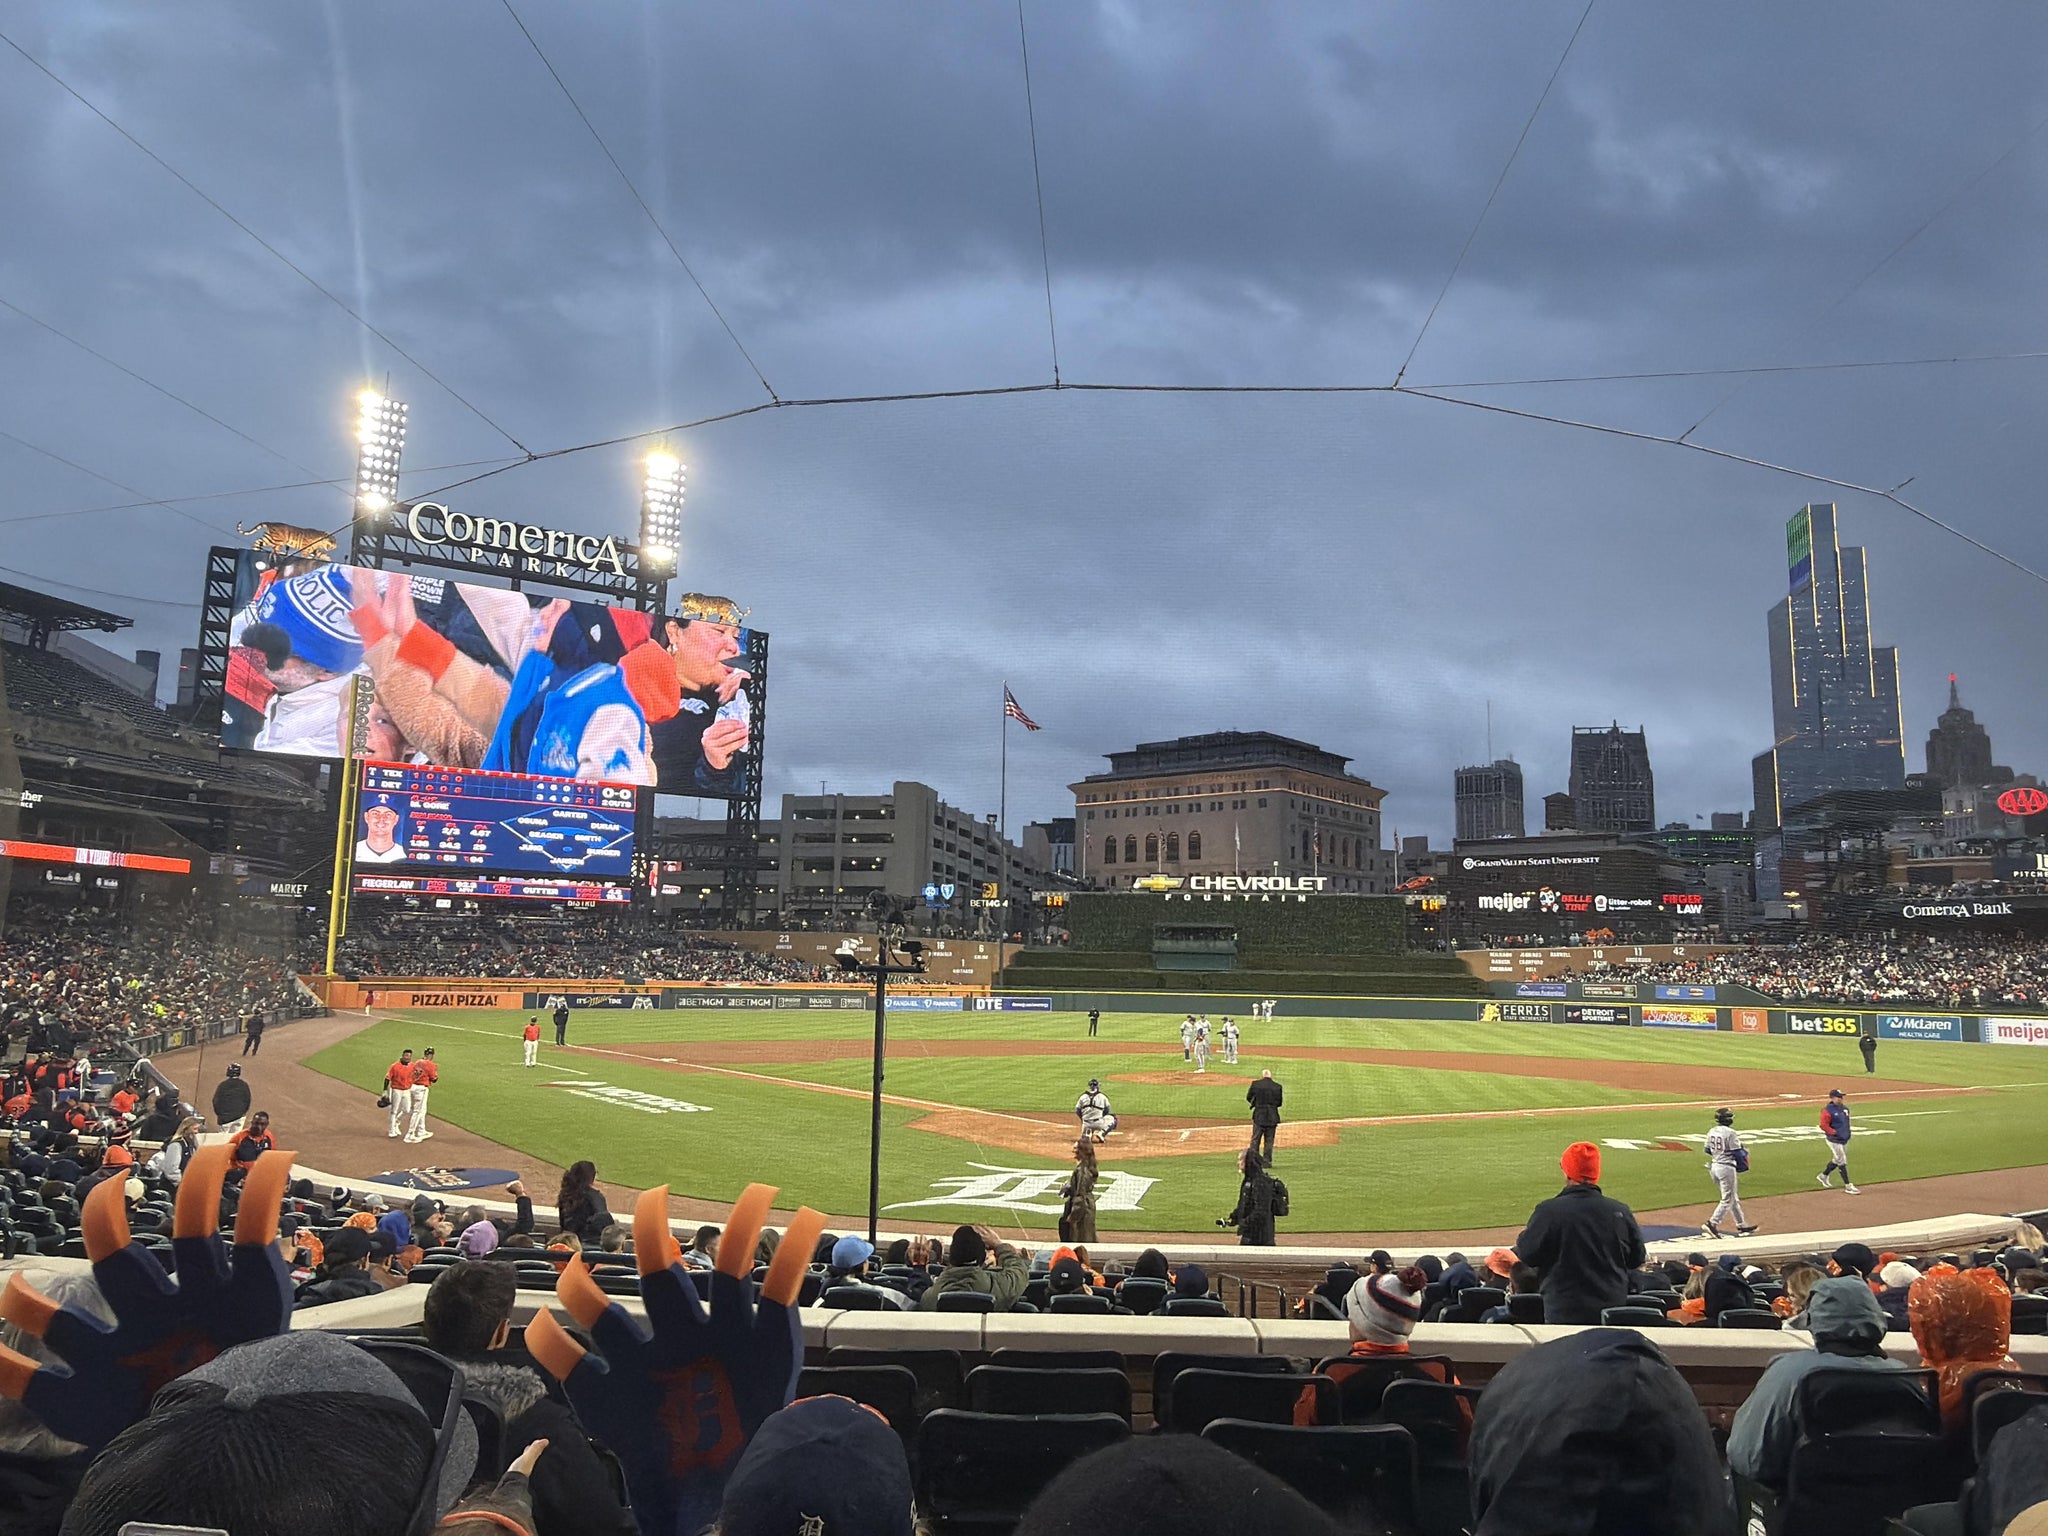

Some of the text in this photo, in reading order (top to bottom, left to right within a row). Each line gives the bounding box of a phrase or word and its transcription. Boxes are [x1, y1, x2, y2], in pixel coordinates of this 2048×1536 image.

[471, 548, 570, 578] PARK
[382, 769, 403, 778] TEX
[381, 780, 402, 789] DET
[2001, 789, 2047, 814] AAA
[1473, 856, 1600, 868] GRAND VALLEY STATE UNIVERSITY
[270, 884, 308, 894] MARKET
[1190, 876, 1327, 891] CHEVROLET
[1165, 894, 1306, 902] FOUNTAIN
[1478, 892, 1530, 912] meijer
[1676, 904, 1702, 914] LAW
[1973, 902, 2013, 915] Bank
[779, 934, 790, 943] 23
[978, 944, 984, 953] 6
[1634, 948, 1642, 956] 11
[1673, 947, 1685, 956] 42
[1592, 950, 1603, 959] 10
[411, 994, 498, 1006] PIZZA! PIZZA!
[687, 998, 723, 1006] BETMGM
[976, 998, 1003, 1010] DTE
[1503, 1005, 1549, 1016] FERRIS
[1582, 1008, 1615, 1017] DETROIT
[1648, 1010, 1688, 1023] Surfside
[1742, 1012, 1757, 1028] hap
[1791, 1015, 1857, 1034] bet365
[1903, 1019, 1952, 1030] McLaren
